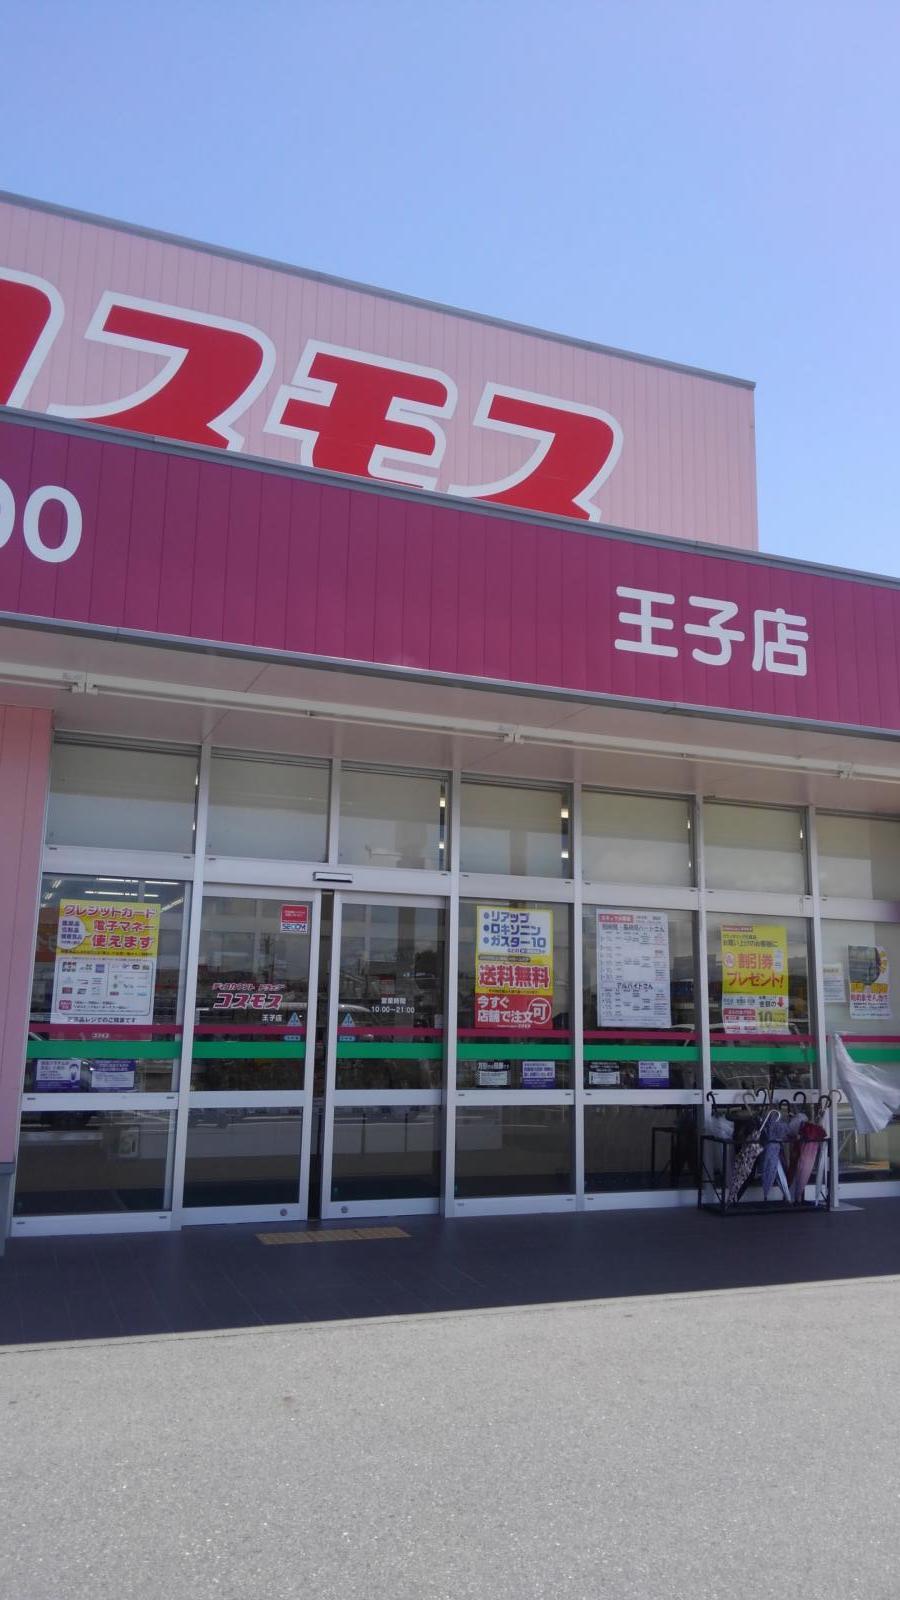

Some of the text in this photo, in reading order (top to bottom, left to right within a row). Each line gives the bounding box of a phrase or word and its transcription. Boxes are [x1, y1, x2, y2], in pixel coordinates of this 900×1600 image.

[0, 267, 624, 522] スモス
[0, 478, 83, 563] 0
[614, 584, 809, 678] 王子店
[64, 904, 156, 918] クレジットカード
[93, 920, 155, 932] 電子マネー
[490, 923, 541, 936] ロキソニン
[92, 934, 153, 949] 使えます
[490, 935, 547, 948] ガスター10
[478, 964, 550, 989] 送料無料
[213, 992, 284, 1010] コスモス
[381, 997, 407, 1005] 営業時間
[478, 995, 510, 1009] 今すぐ
